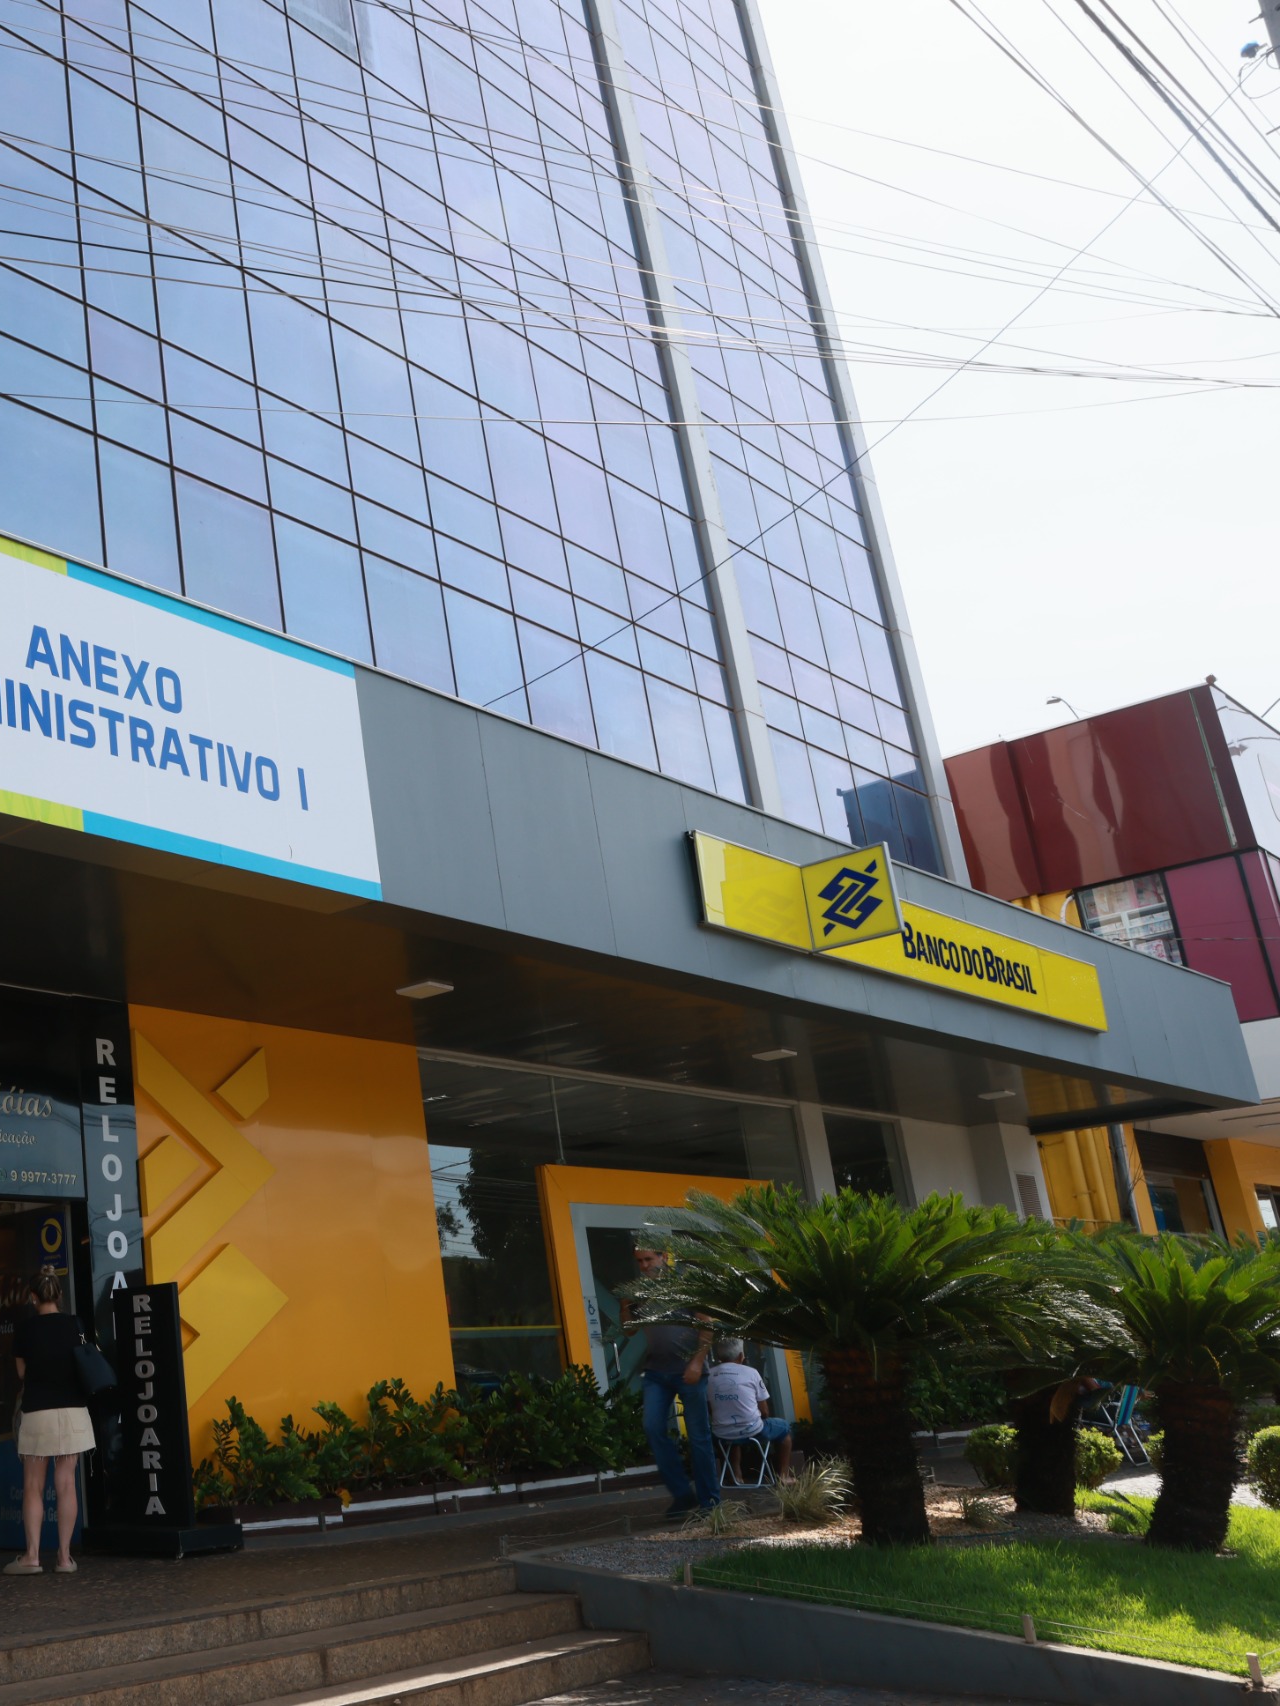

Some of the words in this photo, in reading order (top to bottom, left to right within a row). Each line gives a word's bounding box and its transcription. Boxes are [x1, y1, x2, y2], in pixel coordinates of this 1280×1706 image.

[25, 624, 183, 714] ANEXO
[297, 767, 309, 811] I
[901, 921, 961, 974] BANCO
[960, 945, 985, 980] DO
[982, 945, 1037, 995] BRASIL
[10, 1169, 18, 1182] 9
[21, 1171, 77, 1185] 9977-3777
[95, 1037, 129, 1424] RELOJOA
[133, 1294, 166, 1516] RELOJOARIA
[714, 1393, 739, 1401] Pesca
